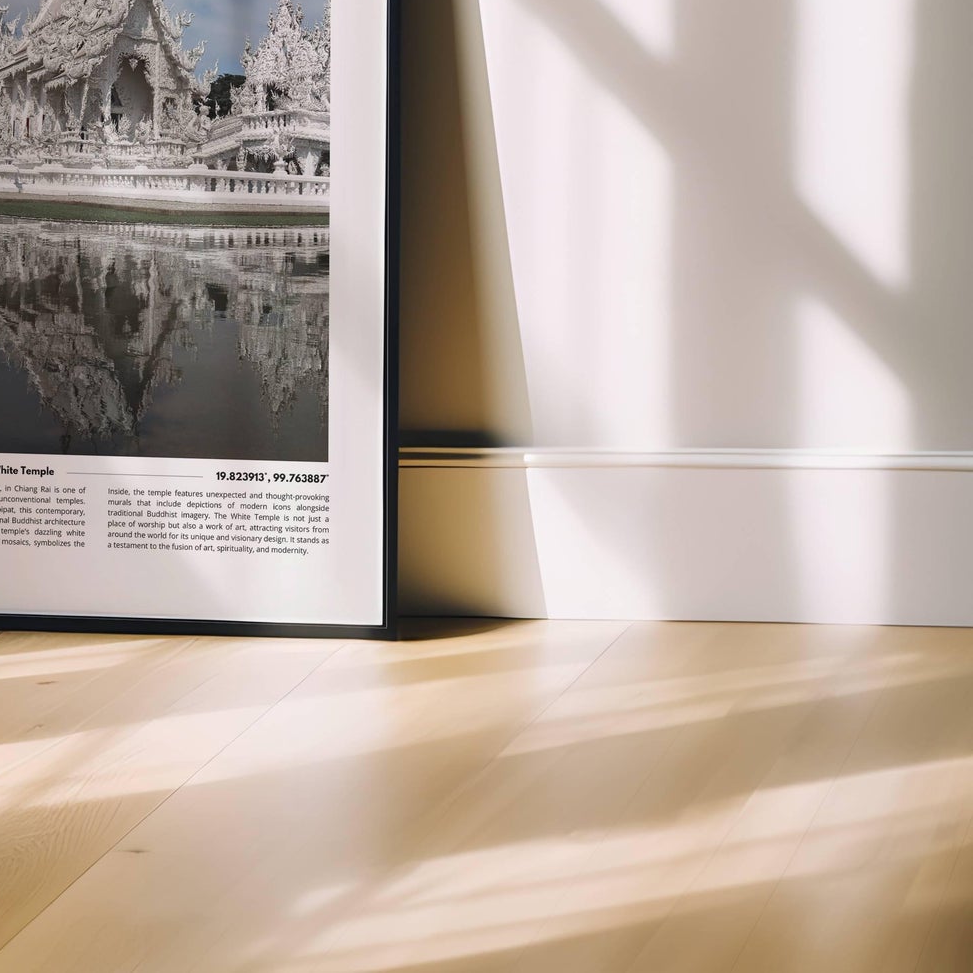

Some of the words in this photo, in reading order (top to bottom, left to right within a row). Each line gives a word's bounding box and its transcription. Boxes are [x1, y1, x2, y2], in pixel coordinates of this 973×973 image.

[20, 465, 54, 477] Temple
[4, 484, 12, 492] in
[13, 484, 38, 494] Chiang
[40, 485, 51, 493] Rai
[53, 485, 60, 493] is
[78, 486, 86, 494] of
[107, 487, 130, 496] Inside,
[132, 488, 145, 496] the
[147, 489, 172, 498] temple
[174, 489, 203, 497] features
[205, 491, 247, 499] unexpected
[265, 492, 330, 503] thought-provoking
[55, 497, 85, 506] temples.
[107, 498, 132, 506] murals
[156, 499, 182, 507] include
[186, 500, 222, 509] depictions
[227, 501, 235, 509] of
[239, 502, 268, 510] modern
[272, 503, 291, 511] icons
[296, 503, 330, 513] alongside
[19, 506, 32, 514] this
[35, 507, 85, 516] contemporary,
[107, 509, 143, 517] traditional
[146, 510, 178, 518] Buddhist
[180, 511, 210, 521] imagery.
[213, 511, 227, 520] The
[230, 512, 251, 520] White
[254, 513, 280, 523] Temple
[307, 515, 321, 524] just
[11, 516, 42, 525] Buddhist
[43, 517, 86, 526] architecture
[107, 519, 126, 528] place
[128, 520, 136, 528] of
[137, 520, 166, 530] worship
[167, 521, 180, 529] but
[181, 521, 197, 529] also
[205, 522, 223, 530] work
[225, 522, 233, 530] of
[249, 524, 283, 534] attracting
[284, 525, 310, 533] visitors
[311, 525, 329, 533] from
[0, 527, 30, 536] temple's
[33, 527, 62, 538] dazzling
[65, 529, 85, 537] white
[107, 530, 133, 538] around
[133, 531, 146, 539] the
[146, 531, 167, 539] world
[168, 531, 179, 539] for
[180, 532, 189, 540] its
[190, 533, 215, 542] unique
[215, 533, 230, 541] and
[230, 534, 263, 544] visionary
[263, 535, 288, 544] design.
[296, 536, 320, 544] stands
[1, 538, 31, 546] mosaics,
[33, 539, 71, 547] symbolizes
[113, 541, 148, 549] testament
[158, 542, 170, 550] the
[171, 542, 193, 550] fusion
[194, 543, 202, 551] of
[216, 544, 255, 554] spirituality,
[255, 545, 270, 553] and
[270, 546, 309, 556] modernity.
